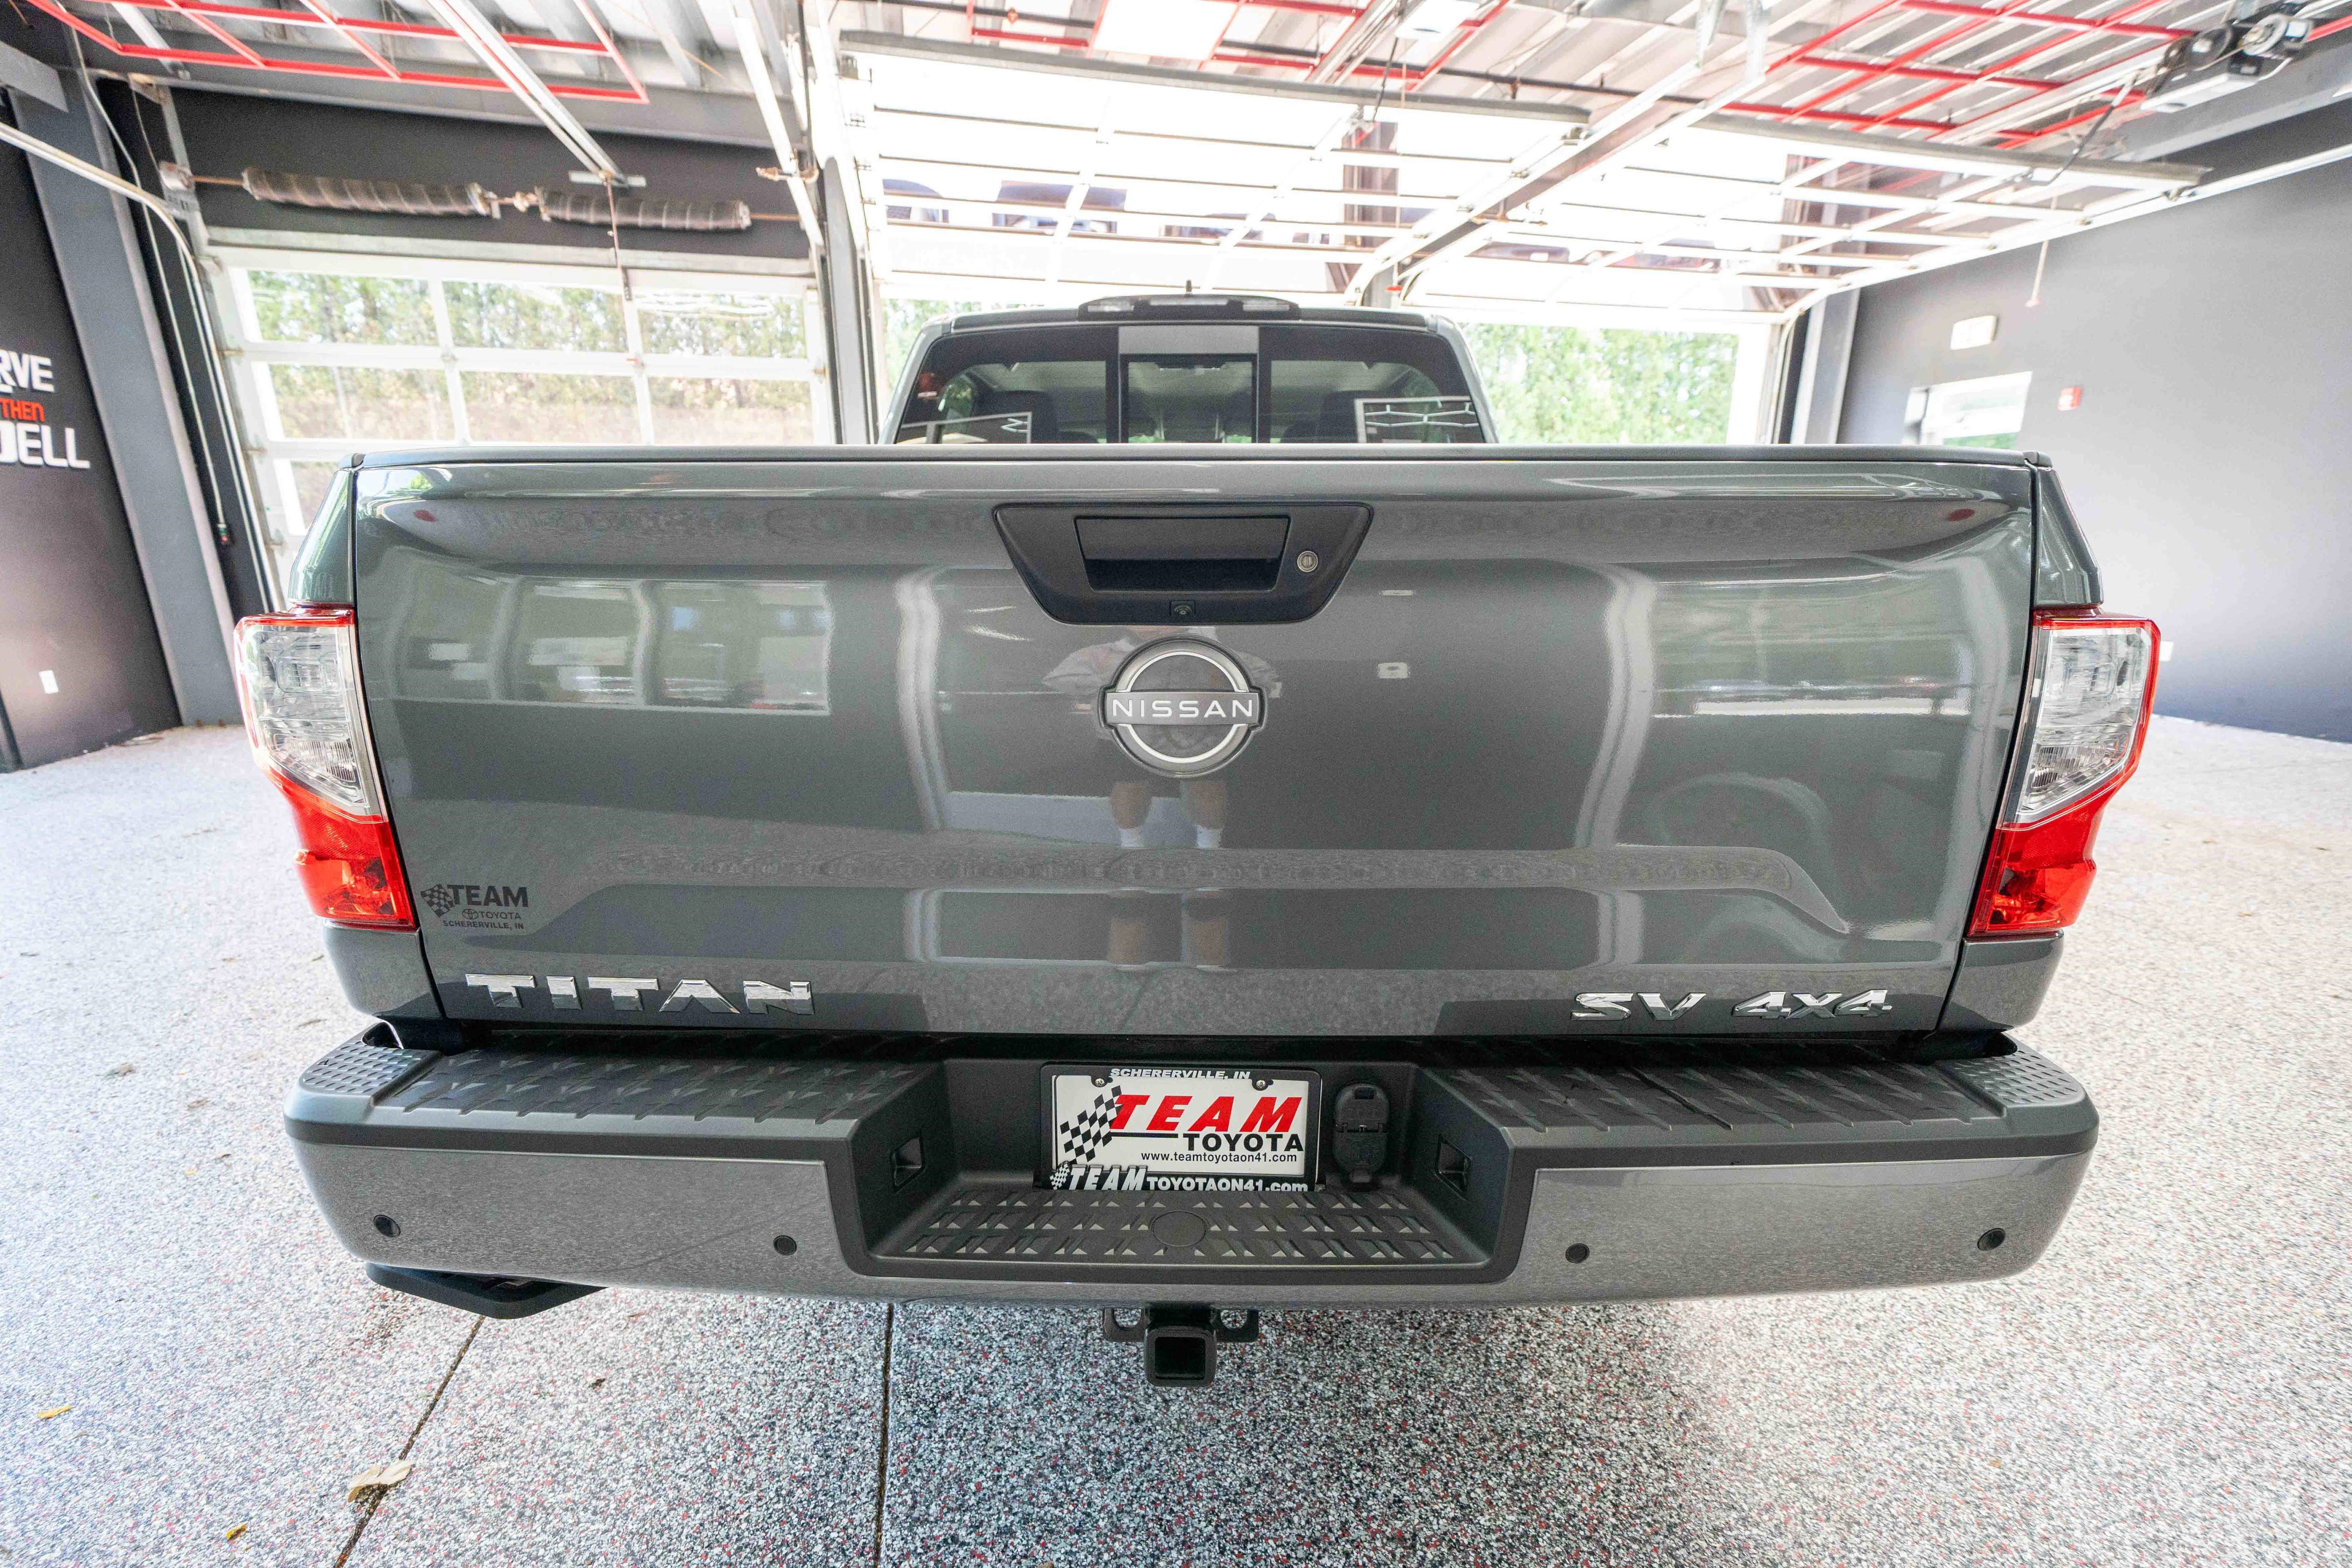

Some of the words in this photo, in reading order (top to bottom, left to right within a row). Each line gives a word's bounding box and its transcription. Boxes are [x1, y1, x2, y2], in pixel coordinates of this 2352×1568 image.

[1112, 699, 1252, 718] NISSAN
[446, 884, 529, 907] TEAM
[479, 911, 522, 920] TOYOTA
[465, 973, 815, 1015] TITAN
[1572, 992, 1707, 1021] SV
[1110, 1095, 1302, 1133] TEAM
[1183, 1133, 1304, 1152] TOYOTA
[1141, 1152, 1297, 1164] www.teamtoyotaon41.com
[1070, 1167, 1147, 1190] TEAM
